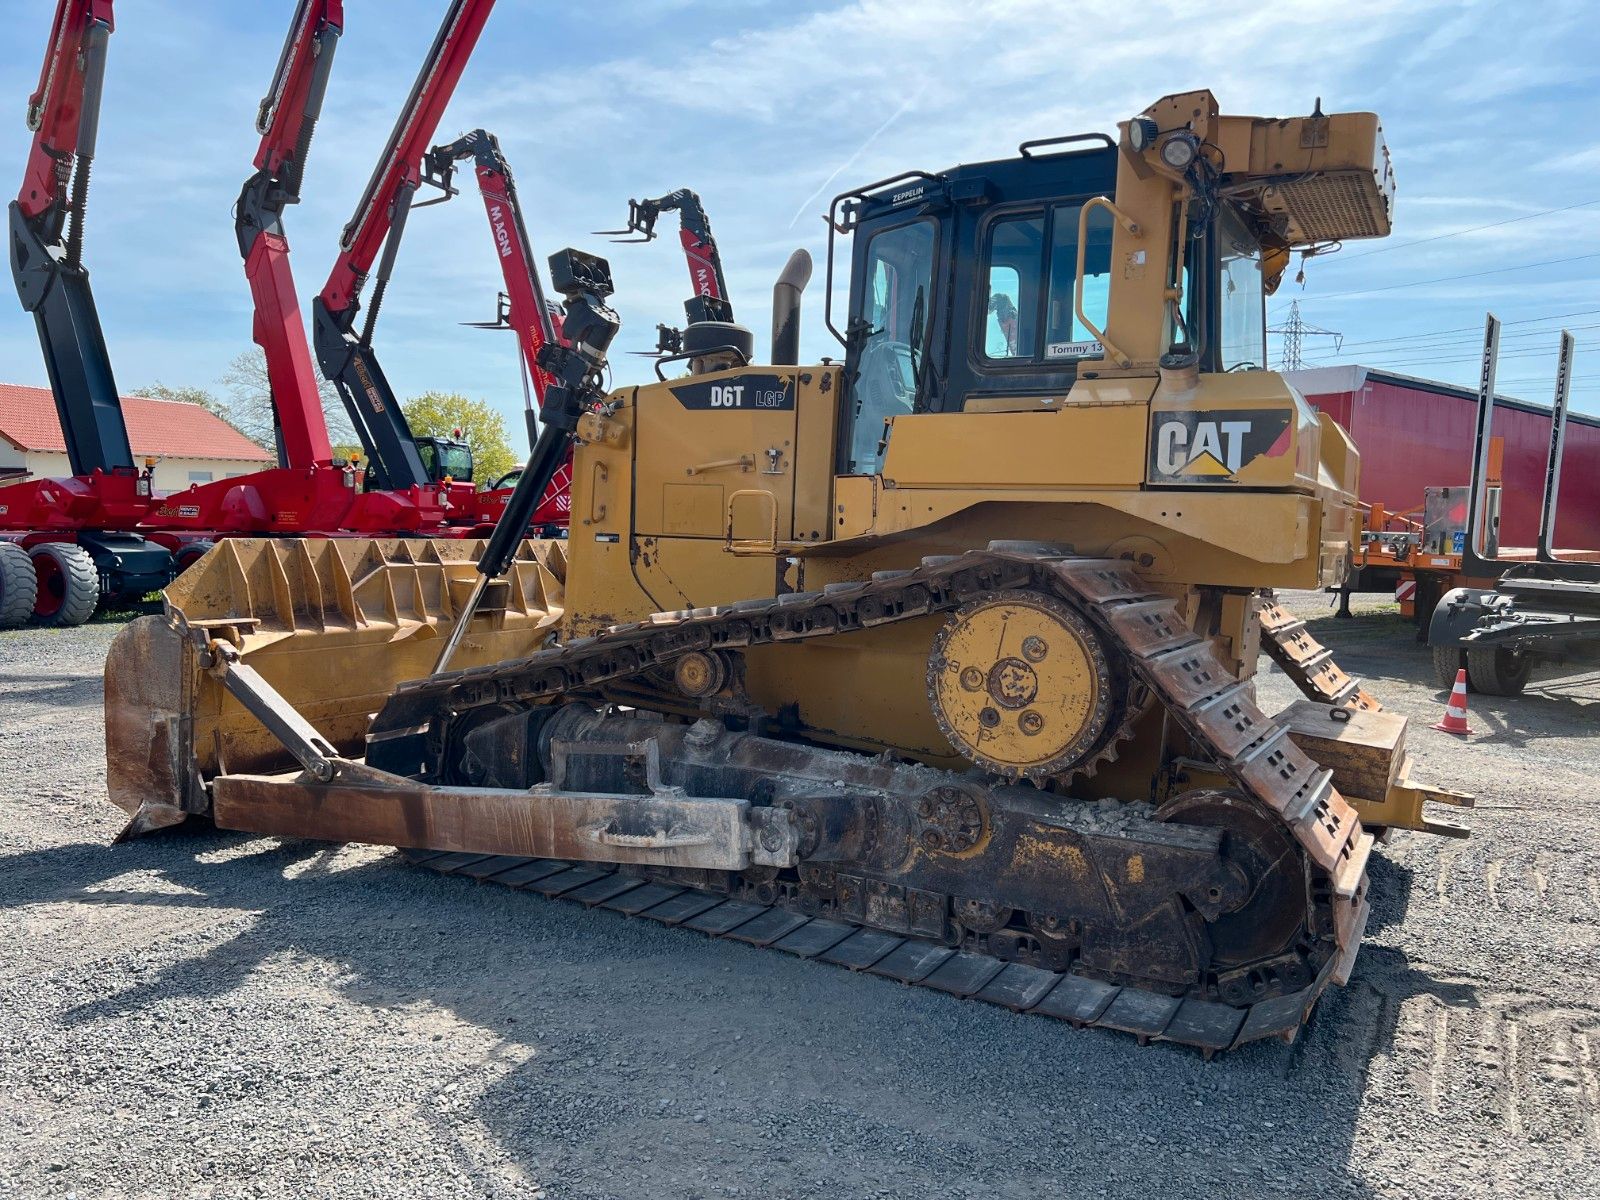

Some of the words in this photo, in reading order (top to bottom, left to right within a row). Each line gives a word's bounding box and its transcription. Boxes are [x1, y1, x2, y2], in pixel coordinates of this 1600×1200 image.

[892, 187, 924, 202] ZEPPELIN
[490, 206, 512, 257] MAGNI
[697, 268, 710, 296] MAG
[1051, 345, 1088, 354] Tommy
[1091, 343, 1103, 352] 13
[711, 386, 744, 407] D6T
[755, 390, 785, 407] LGP
[1157, 421, 1252, 475] CAT
